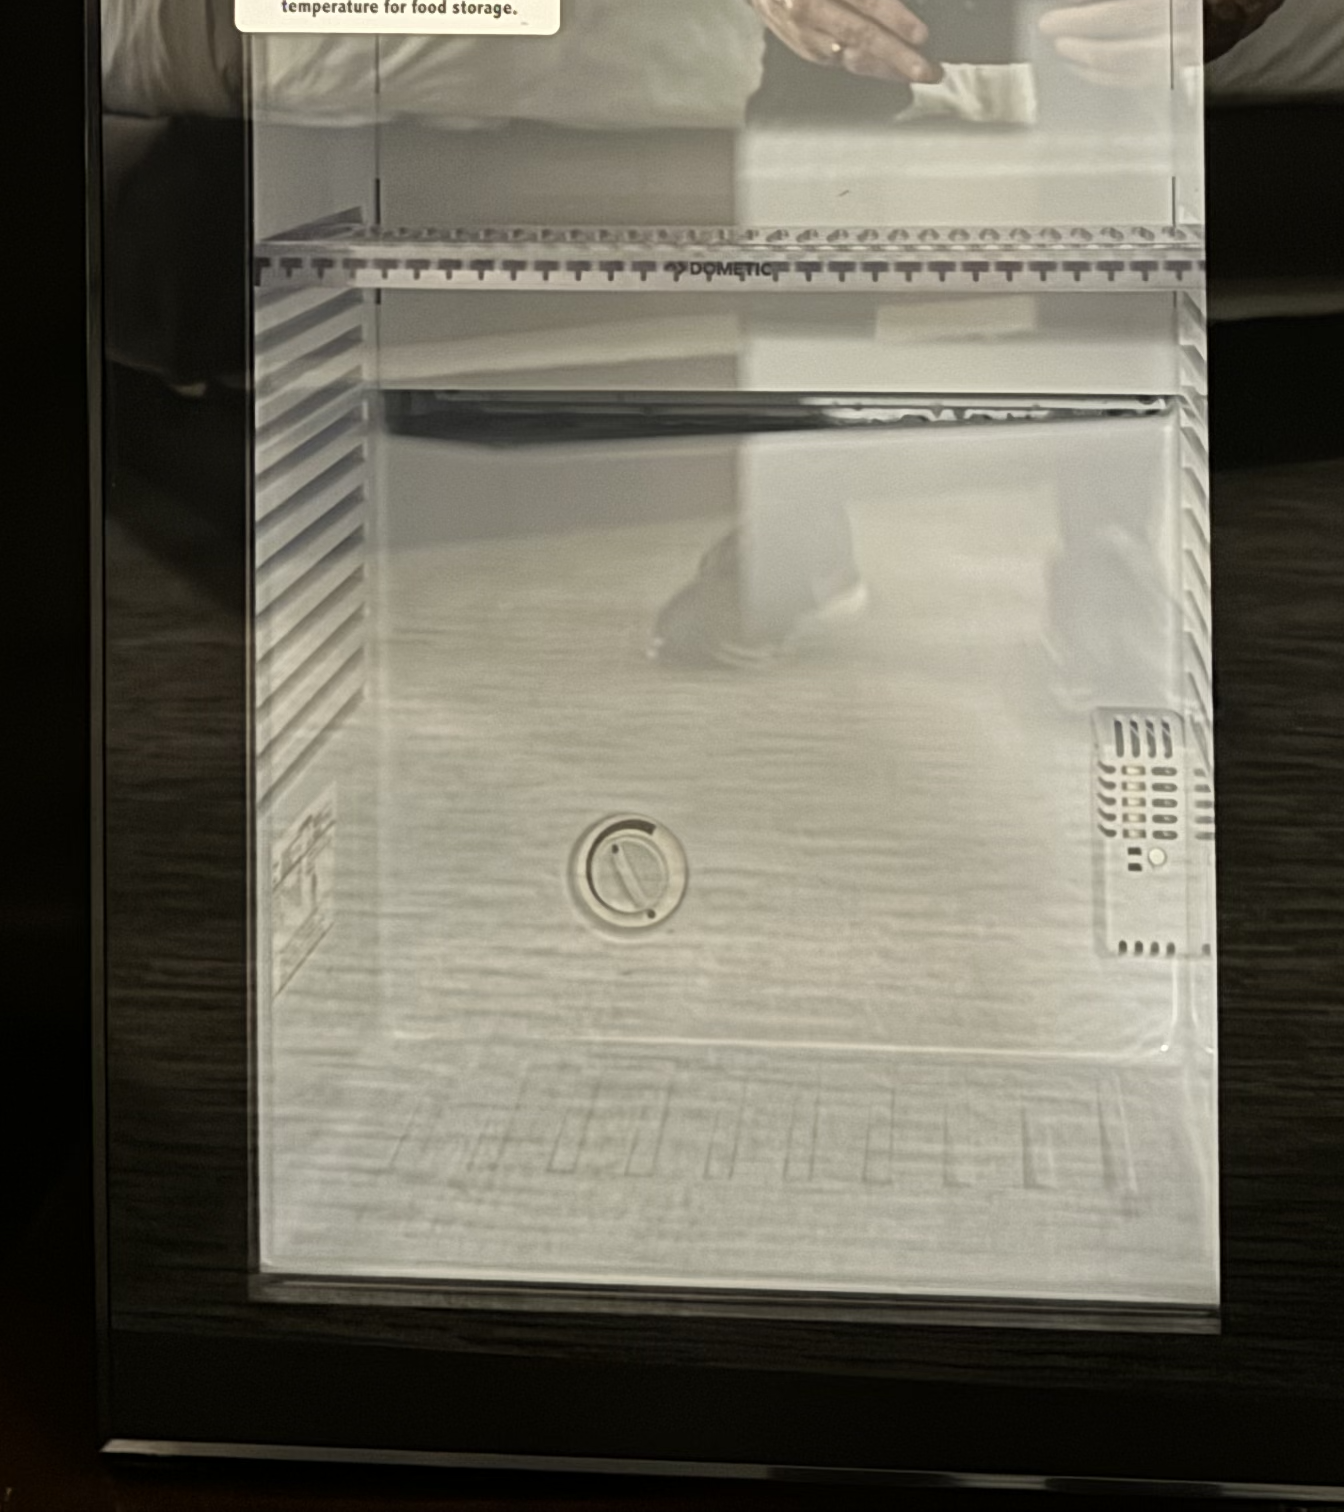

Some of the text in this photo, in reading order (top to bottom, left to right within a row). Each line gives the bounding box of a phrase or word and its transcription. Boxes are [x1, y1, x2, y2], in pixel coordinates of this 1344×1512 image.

[282, 0, 518, 18] temperature for food storage.
[690, 262, 772, 276] DOMETIC
